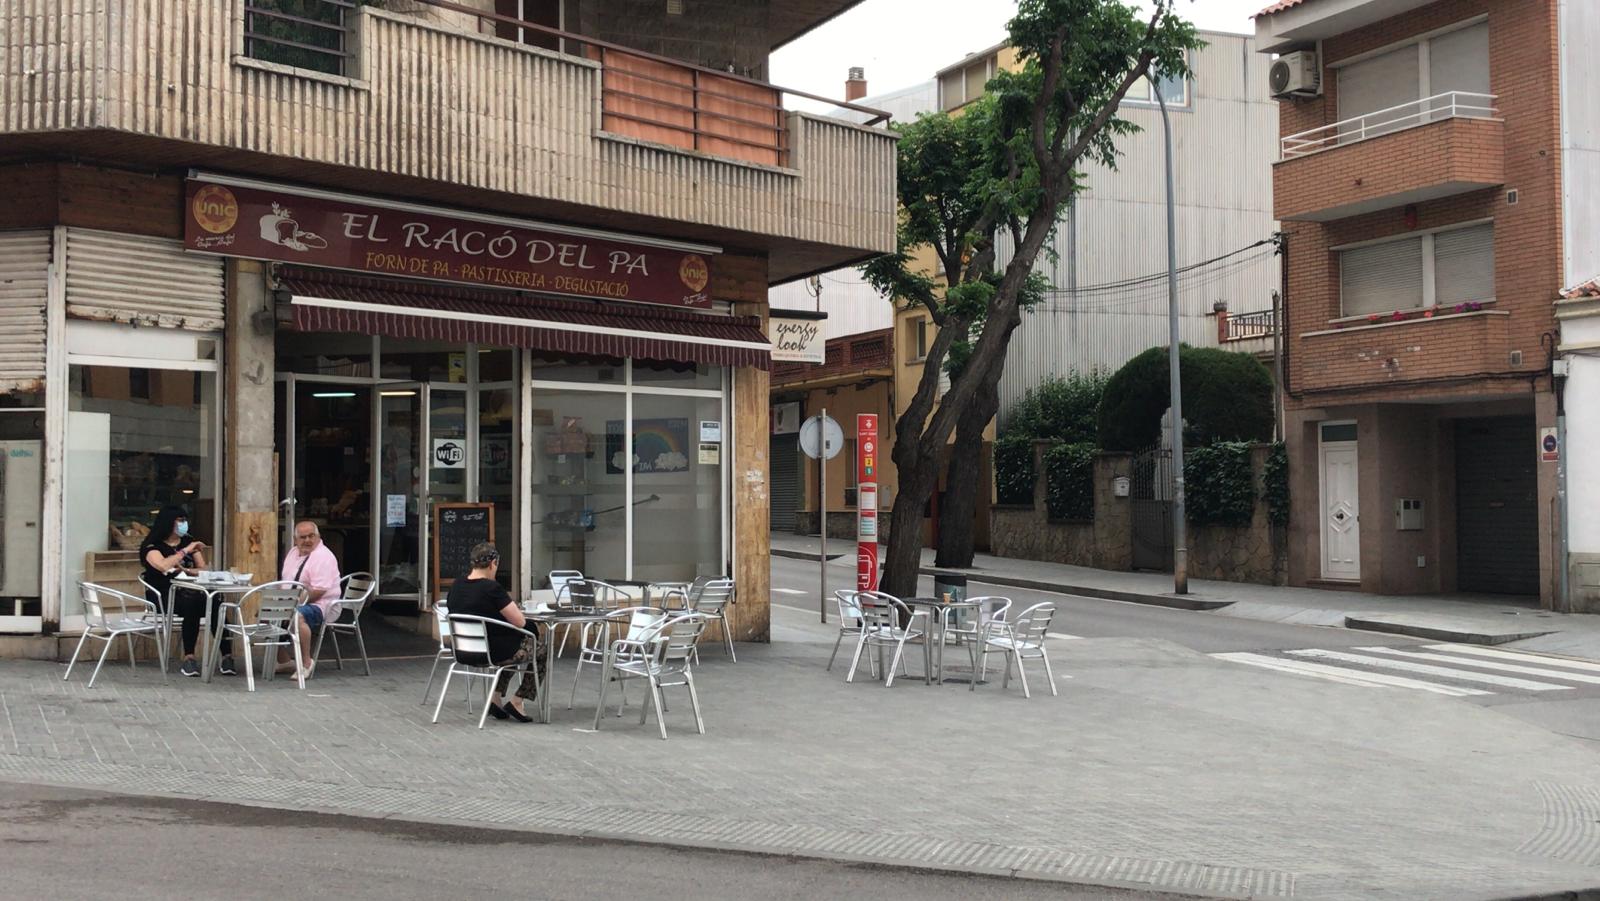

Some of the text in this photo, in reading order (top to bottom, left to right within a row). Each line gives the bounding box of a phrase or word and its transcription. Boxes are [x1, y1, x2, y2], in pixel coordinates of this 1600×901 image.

[342, 213, 649, 276] EL RACÓ DEL PA
[366, 251, 408, 271] FORN
[410, 257, 430, 273] DE
[433, 260, 449, 276] PA
[461, 263, 545, 287] PASTISSERIA
[555, 275, 629, 297] DEGUSTACIÓ
[776, 322, 818, 341] energy
[777, 333, 807, 351] look
